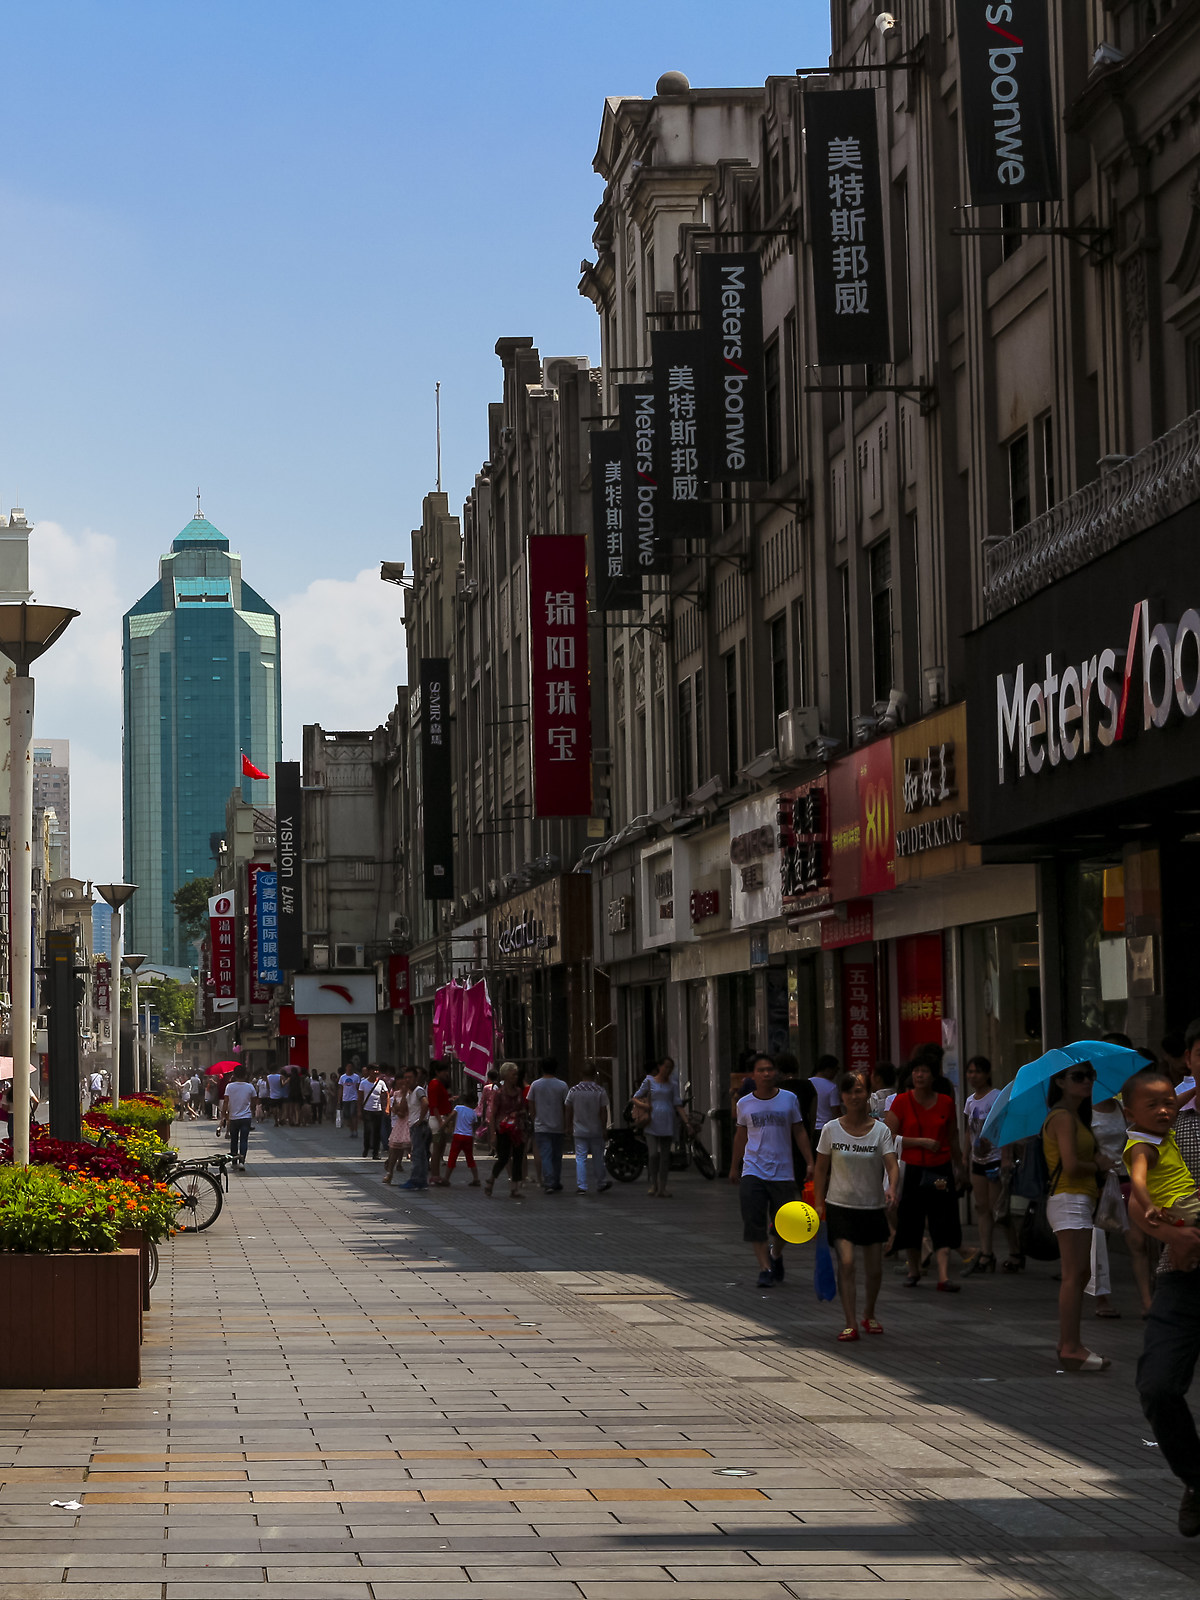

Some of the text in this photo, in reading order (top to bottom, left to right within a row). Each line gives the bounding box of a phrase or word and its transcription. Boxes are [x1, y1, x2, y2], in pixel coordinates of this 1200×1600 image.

[985, 0, 1025, 185] s/bonwe
[828, 136, 870, 315] 美特斯邦威
[668, 365, 699, 501] 美特斯邦威
[720, 266, 748, 470] Meters/bonwe
[545, 590, 577, 762] 锦阳珠宝
[865, 778, 890, 861] 80
[832, 1142, 878, 1153] BORN SINNER
